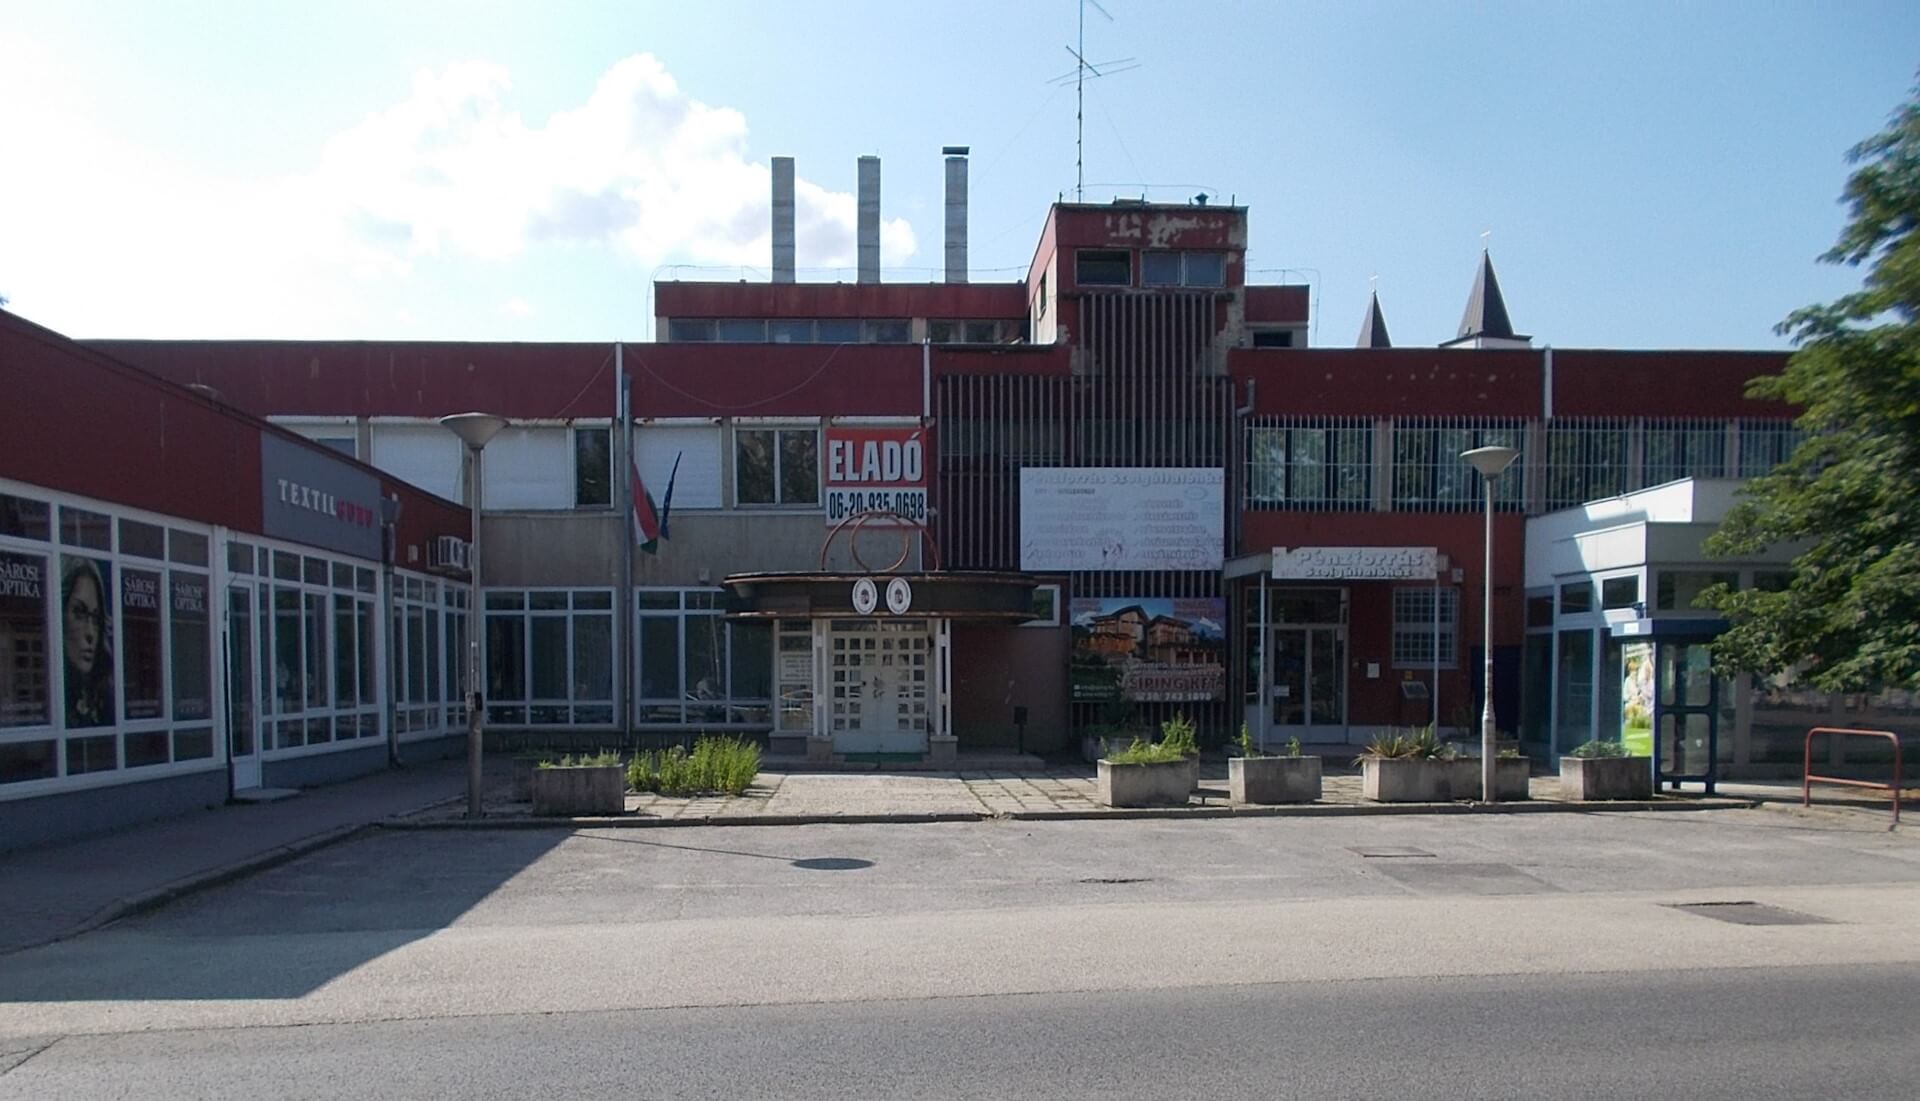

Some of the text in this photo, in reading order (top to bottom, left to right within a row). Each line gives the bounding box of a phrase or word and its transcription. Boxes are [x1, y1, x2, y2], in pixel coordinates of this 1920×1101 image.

[828, 431, 922, 482] ELADÓ
[1296, 549, 1424, 567] Pénzforrás
[124, 592, 157, 608] OPTIKA
